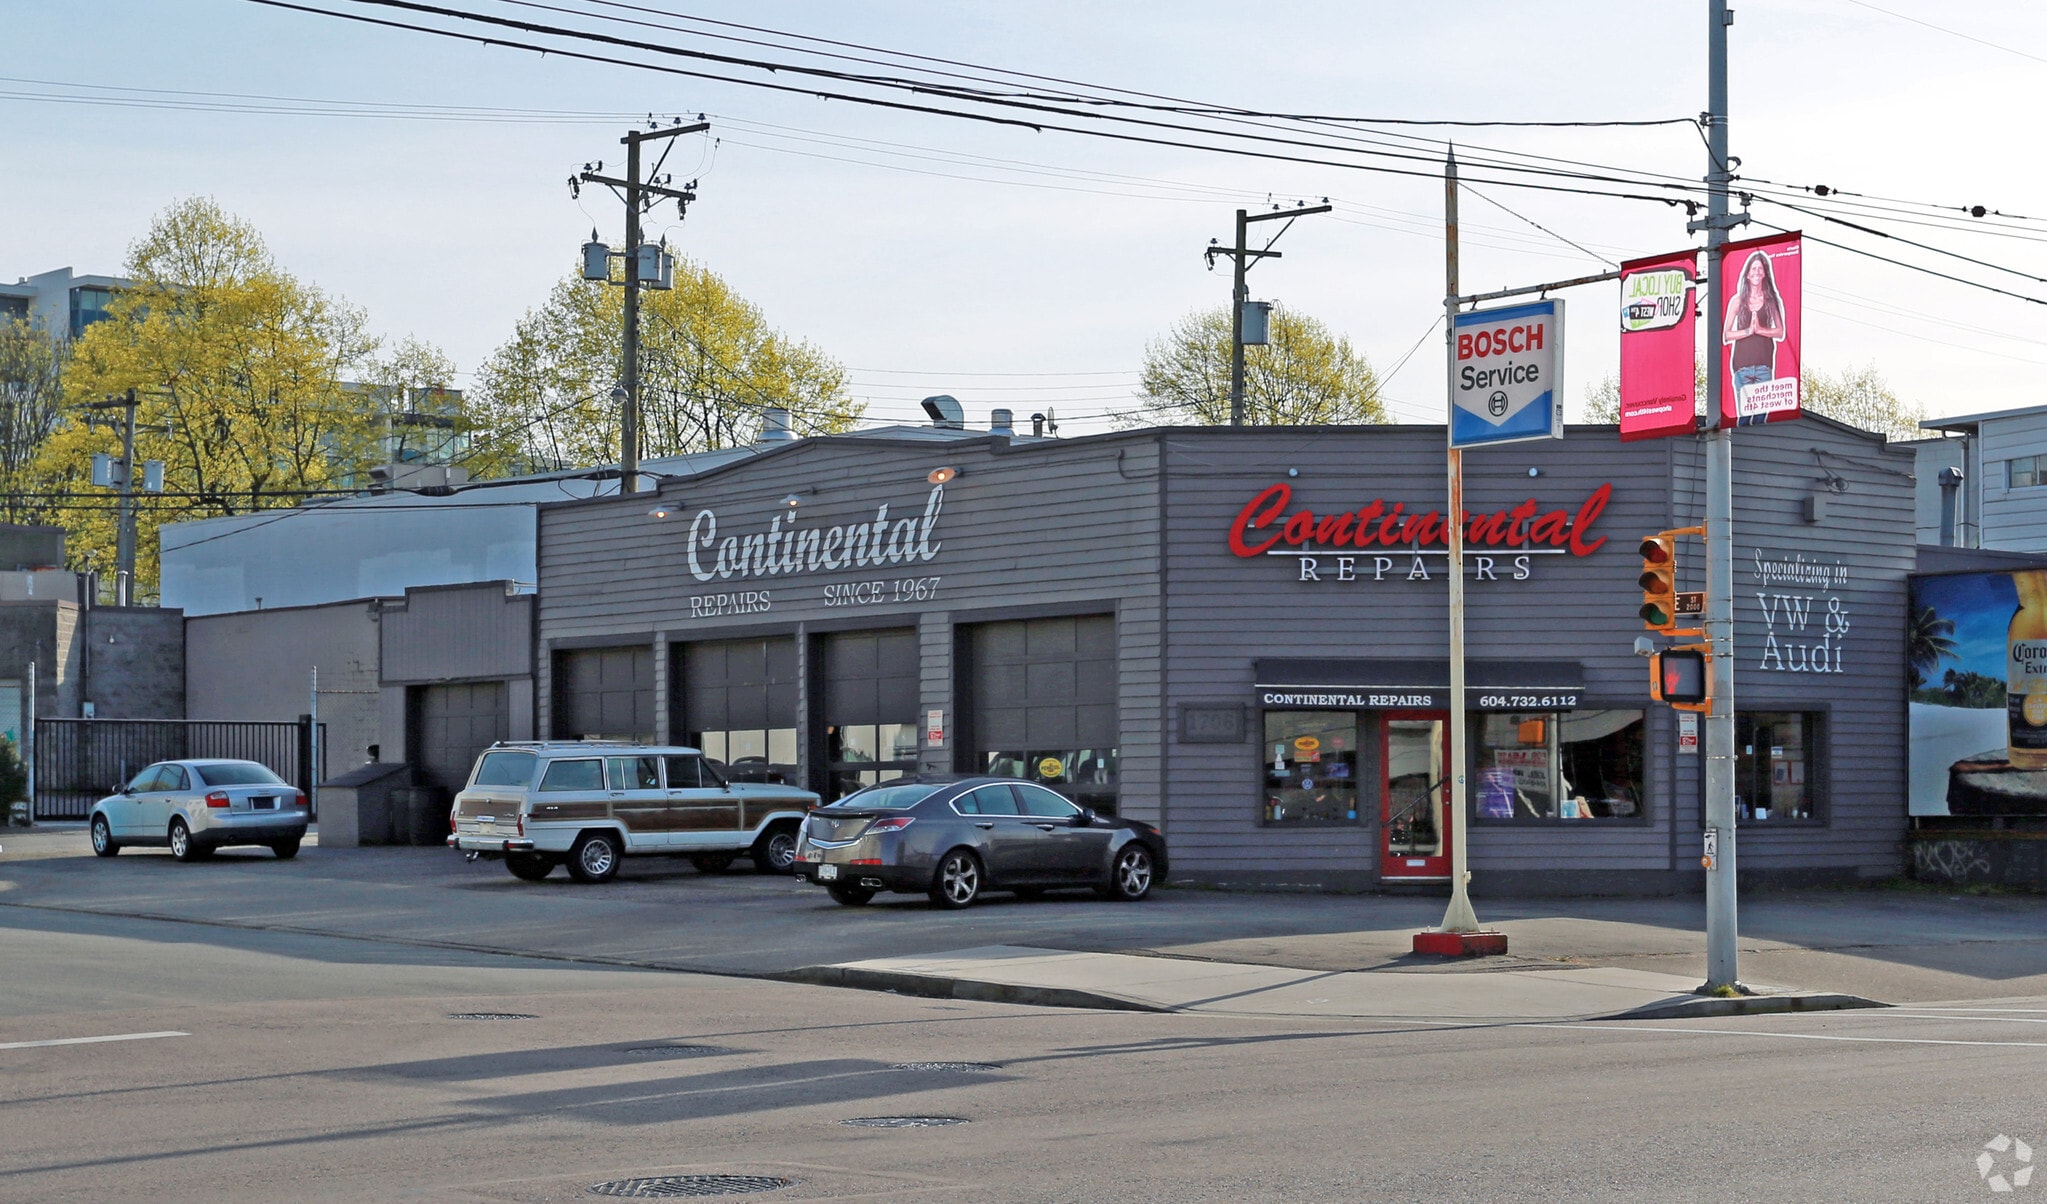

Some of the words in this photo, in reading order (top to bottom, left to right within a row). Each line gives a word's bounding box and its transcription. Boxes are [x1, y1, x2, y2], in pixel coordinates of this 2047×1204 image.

[1457, 323, 1543, 360] BOSCH
[1460, 360, 1539, 391] Service
[687, 484, 946, 582] Continental
[1298, 556, 1531, 581] REPARS
[1753, 548, 1831, 593] Specializing
[1834, 560, 1848, 584] in
[690, 590, 771, 618] REPAIRS
[823, 581, 885, 606] SINCE
[891, 577, 942, 603] 1967
[1690, 596, 1697, 604] ST
[1756, 592, 1814, 631] VW
[1825, 597, 1850, 633] &
[1760, 631, 1844, 672] Audi
[1263, 693, 1365, 706] CONTINENTAL
[1369, 695, 1432, 706] REPAIRS
[1479, 695, 1577, 707] 604.732.6112
